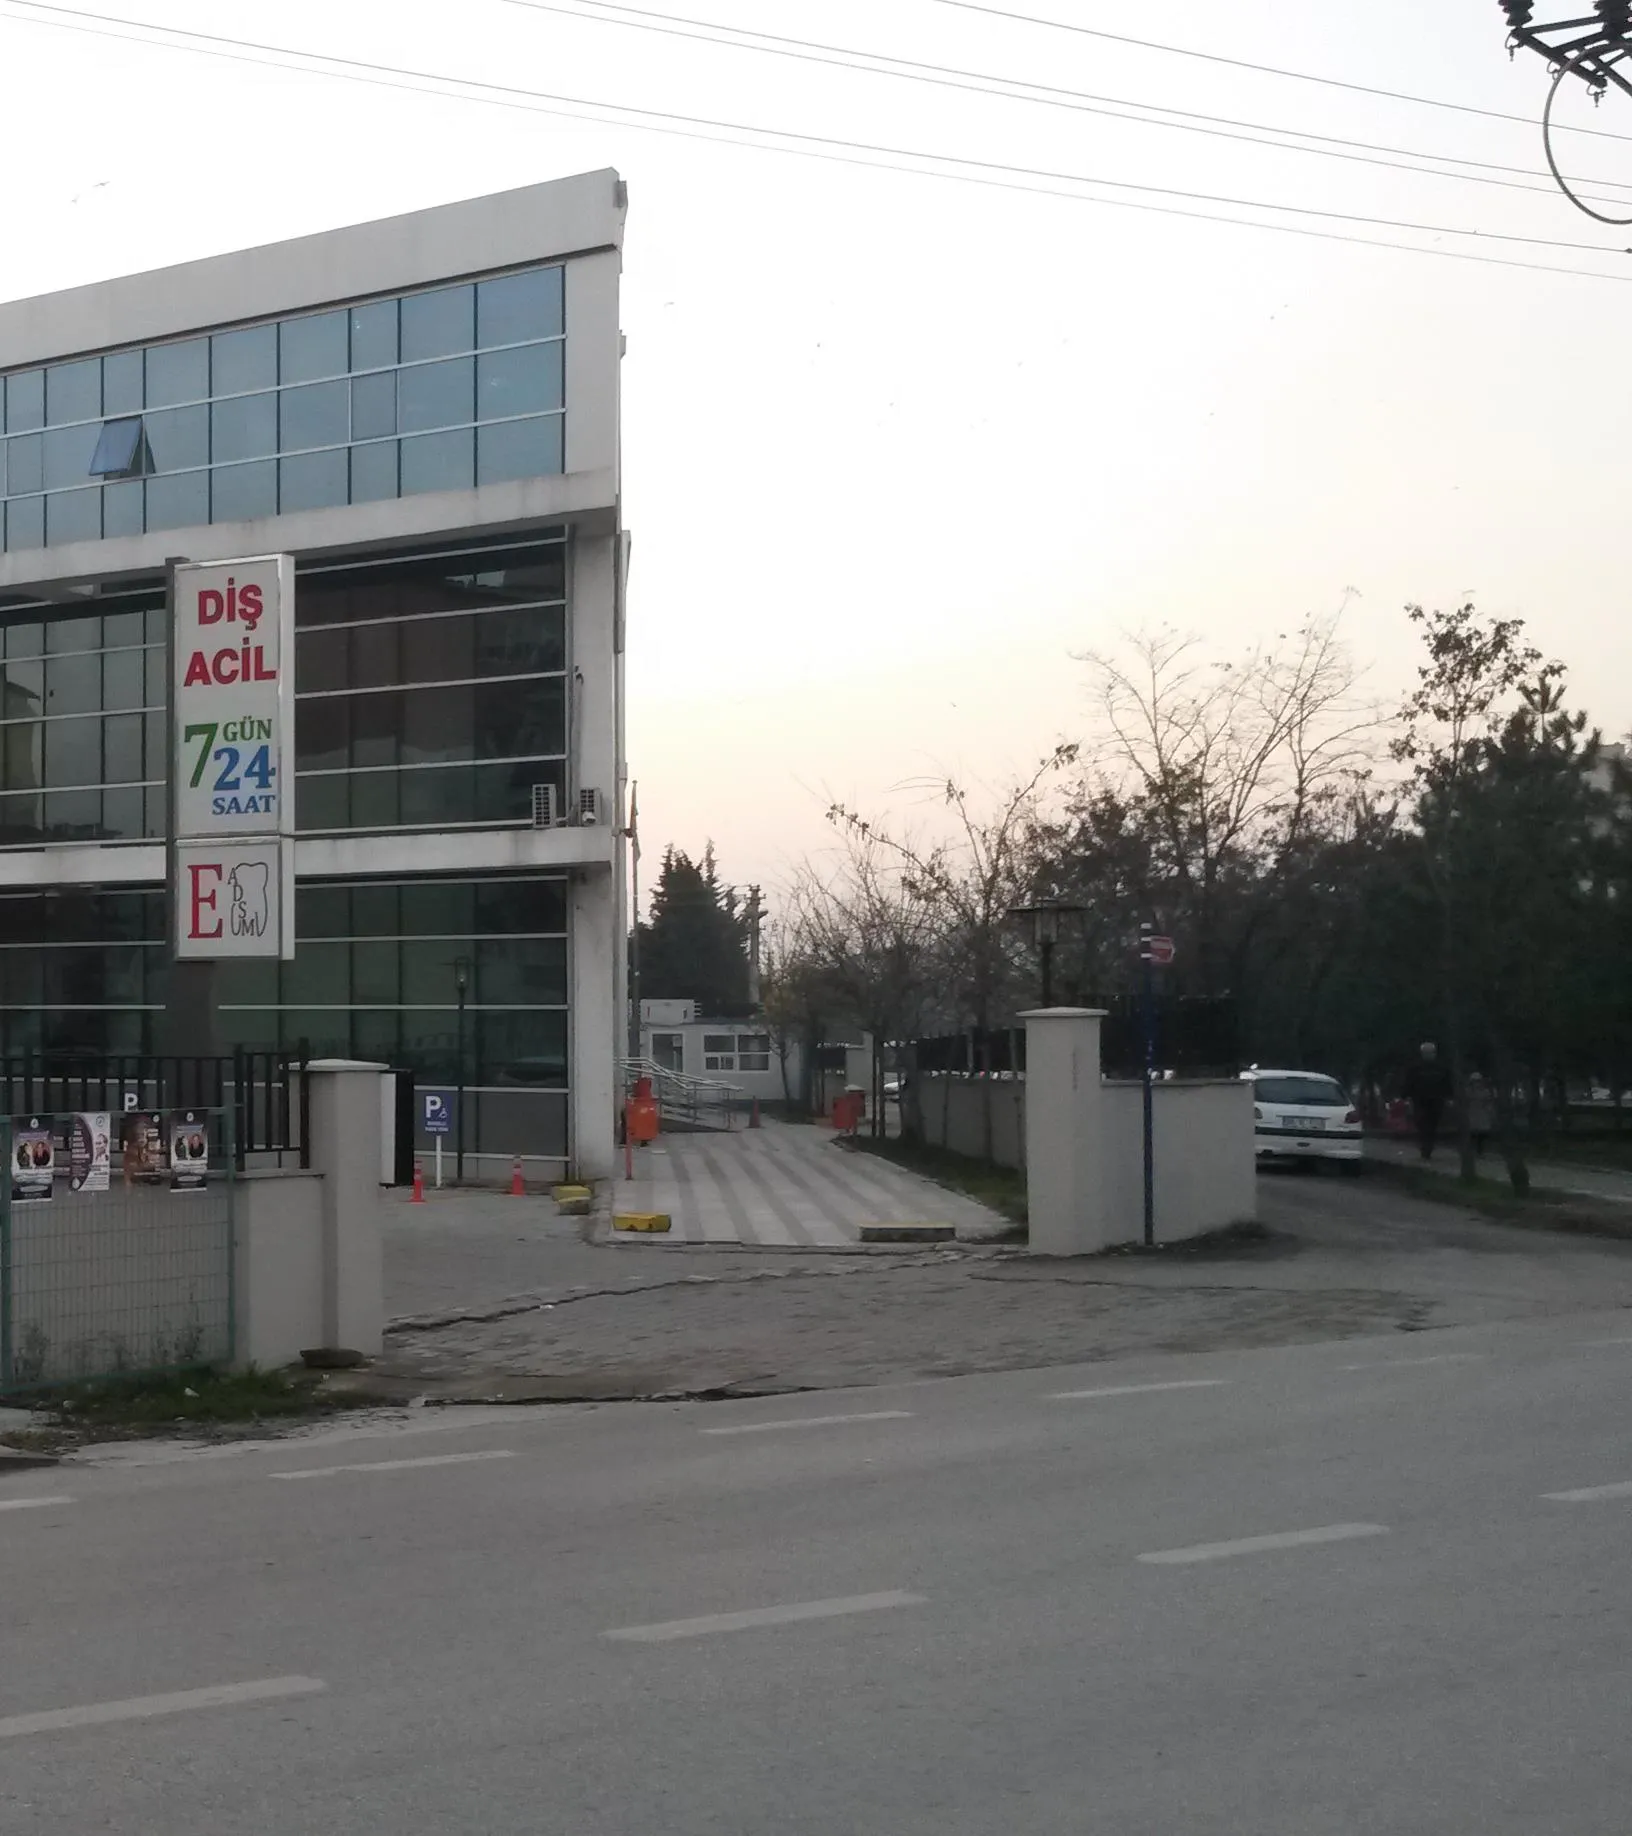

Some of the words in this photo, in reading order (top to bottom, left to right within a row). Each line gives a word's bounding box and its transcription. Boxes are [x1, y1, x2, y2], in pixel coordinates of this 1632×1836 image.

[197, 577, 263, 631] DİŞ
[183, 636, 277, 687] ACİL
[184, 723, 219, 788] 7
[223, 715, 273, 742] GÜN
[213, 744, 276, 791] 24
[212, 794, 276, 815] SAAT
[187, 863, 223, 938] E
[426, 1095, 442, 1118] P
